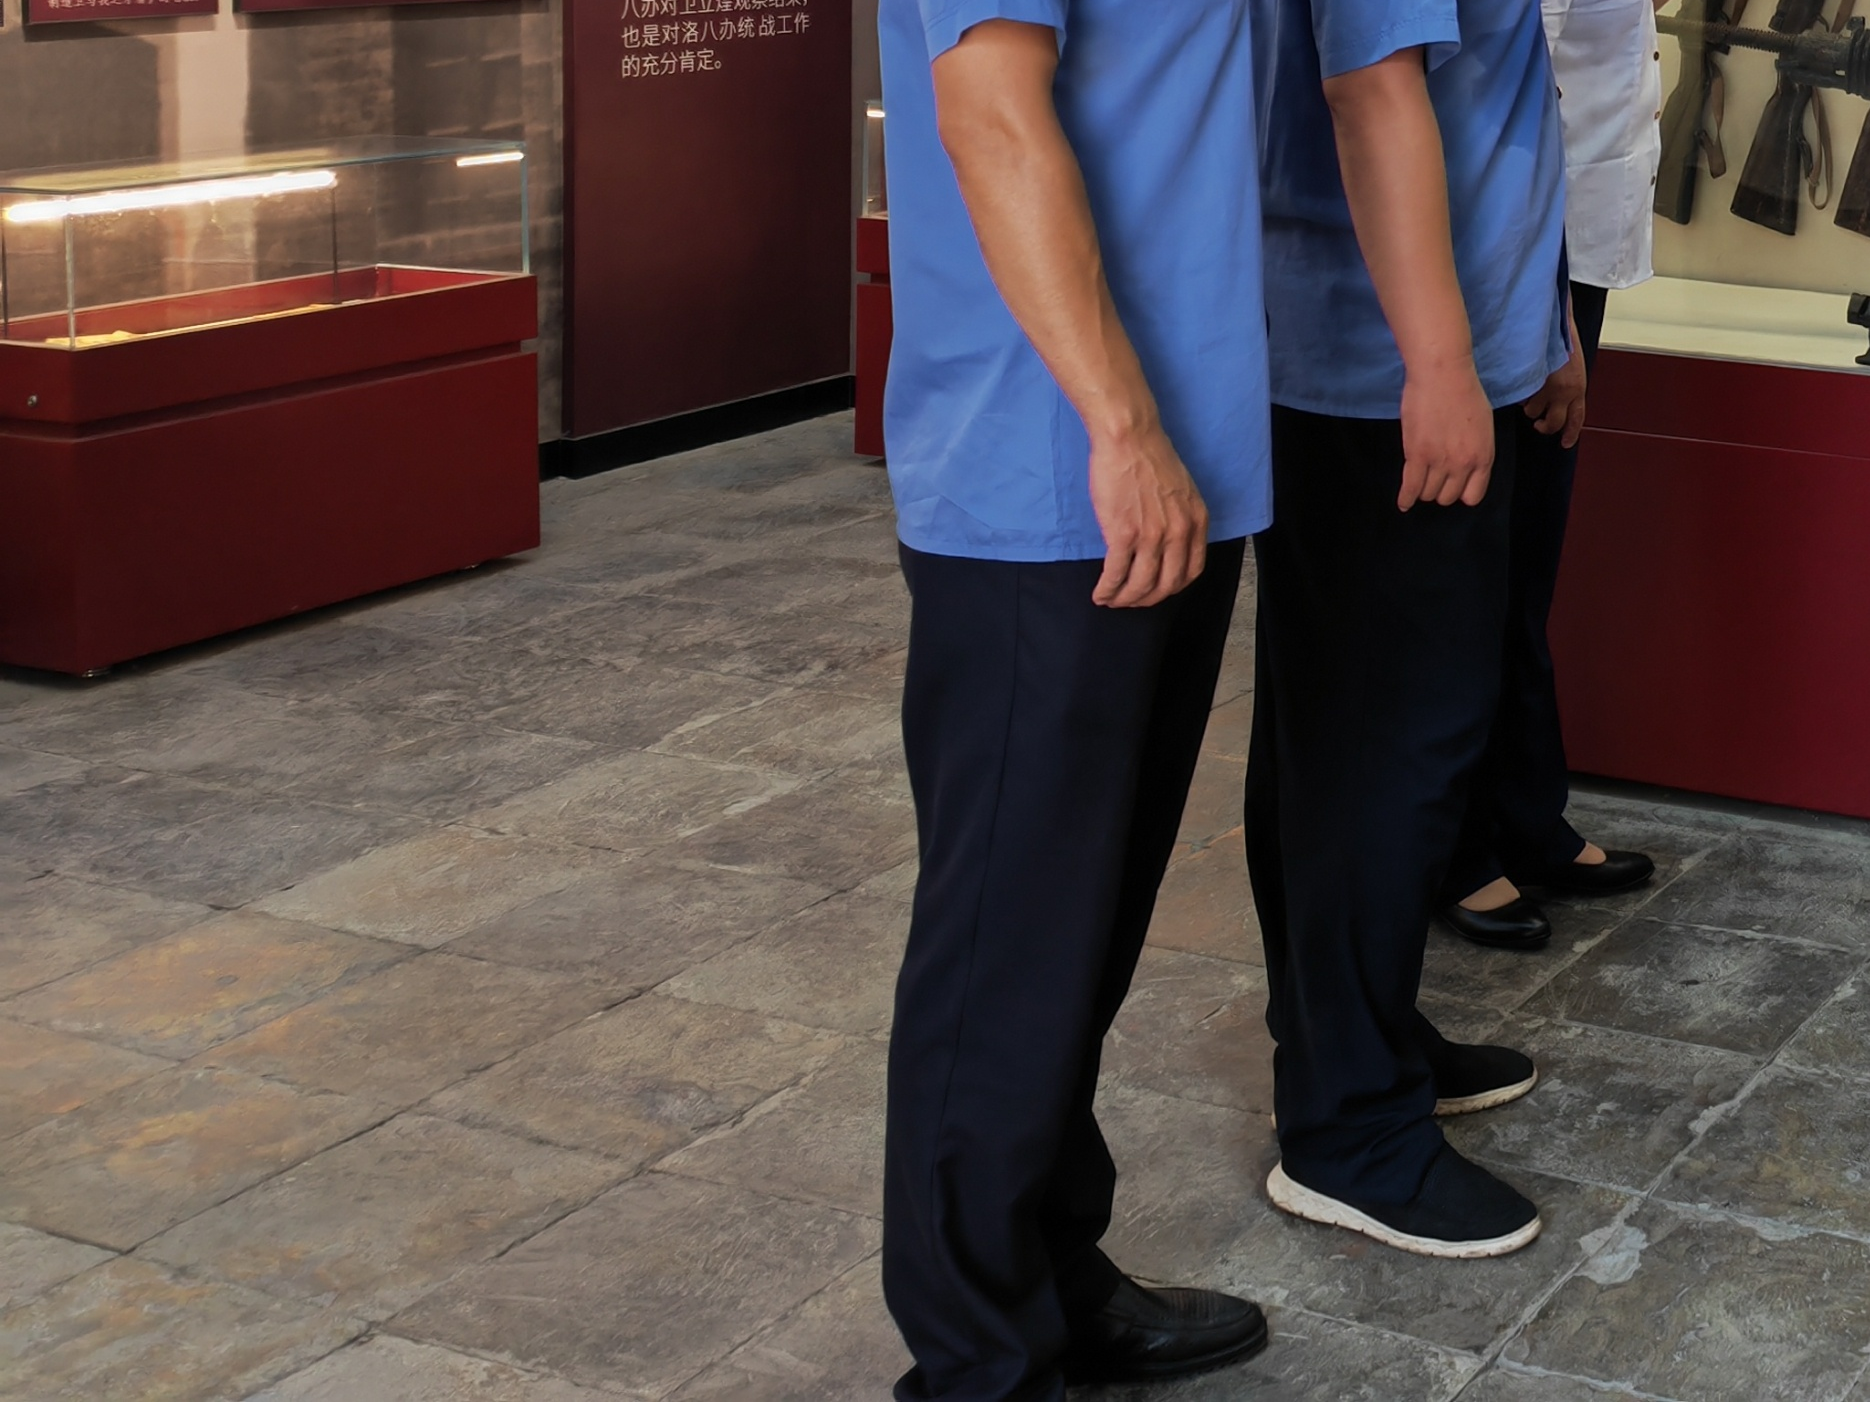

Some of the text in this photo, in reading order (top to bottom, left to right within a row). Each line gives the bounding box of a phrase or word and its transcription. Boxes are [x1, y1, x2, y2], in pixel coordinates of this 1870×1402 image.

[621, 12, 809, 48] 也是对洛八办统战工作
[622, 49, 722, 78] 的充分肯定。
